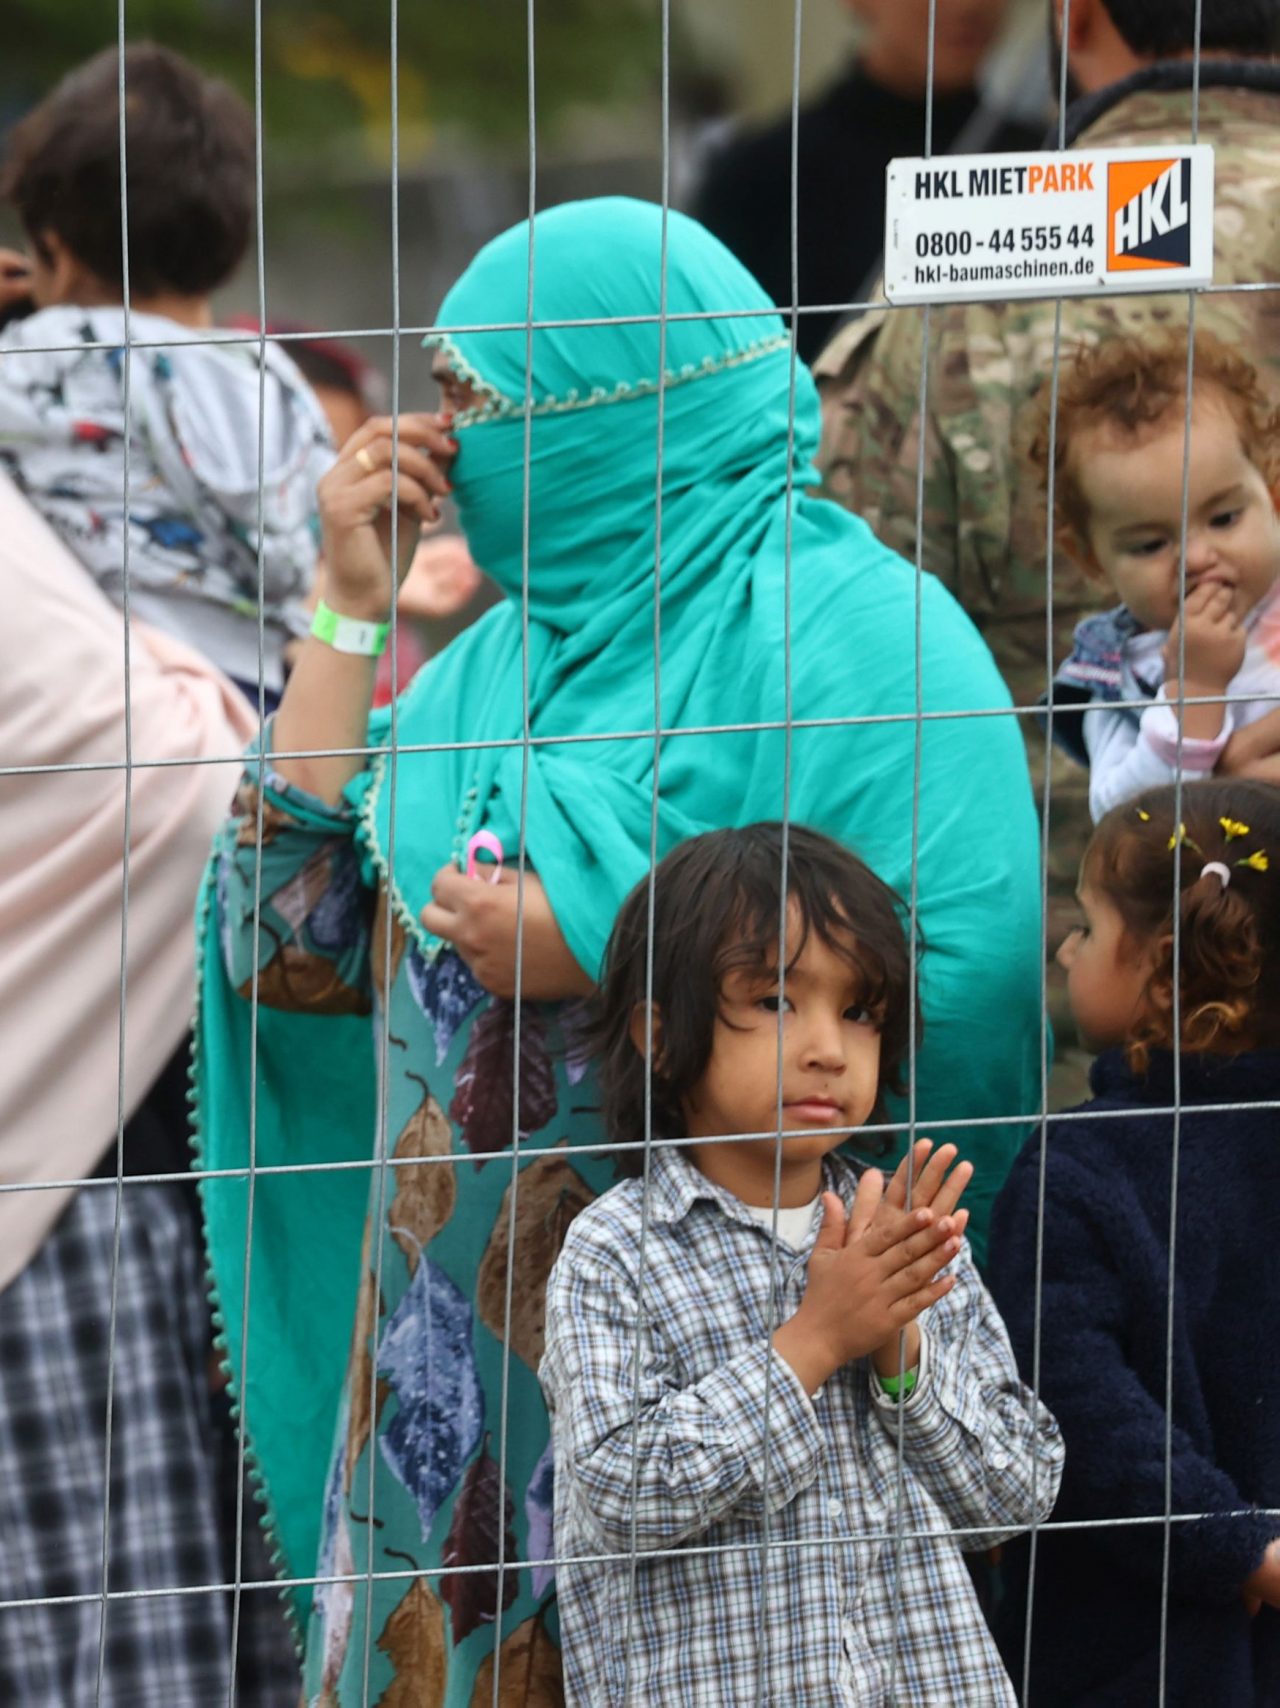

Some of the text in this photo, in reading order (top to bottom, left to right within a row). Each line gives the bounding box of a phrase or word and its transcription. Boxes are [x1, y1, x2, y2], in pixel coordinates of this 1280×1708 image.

[915, 163, 1094, 200] HKL MIETPARK
[1115, 158, 1188, 256] HKL
[1021, 225, 1061, 252] 555
[1067, 224, 1094, 249] 44
[915, 257, 1094, 284] hkl-baumaschinen.de
